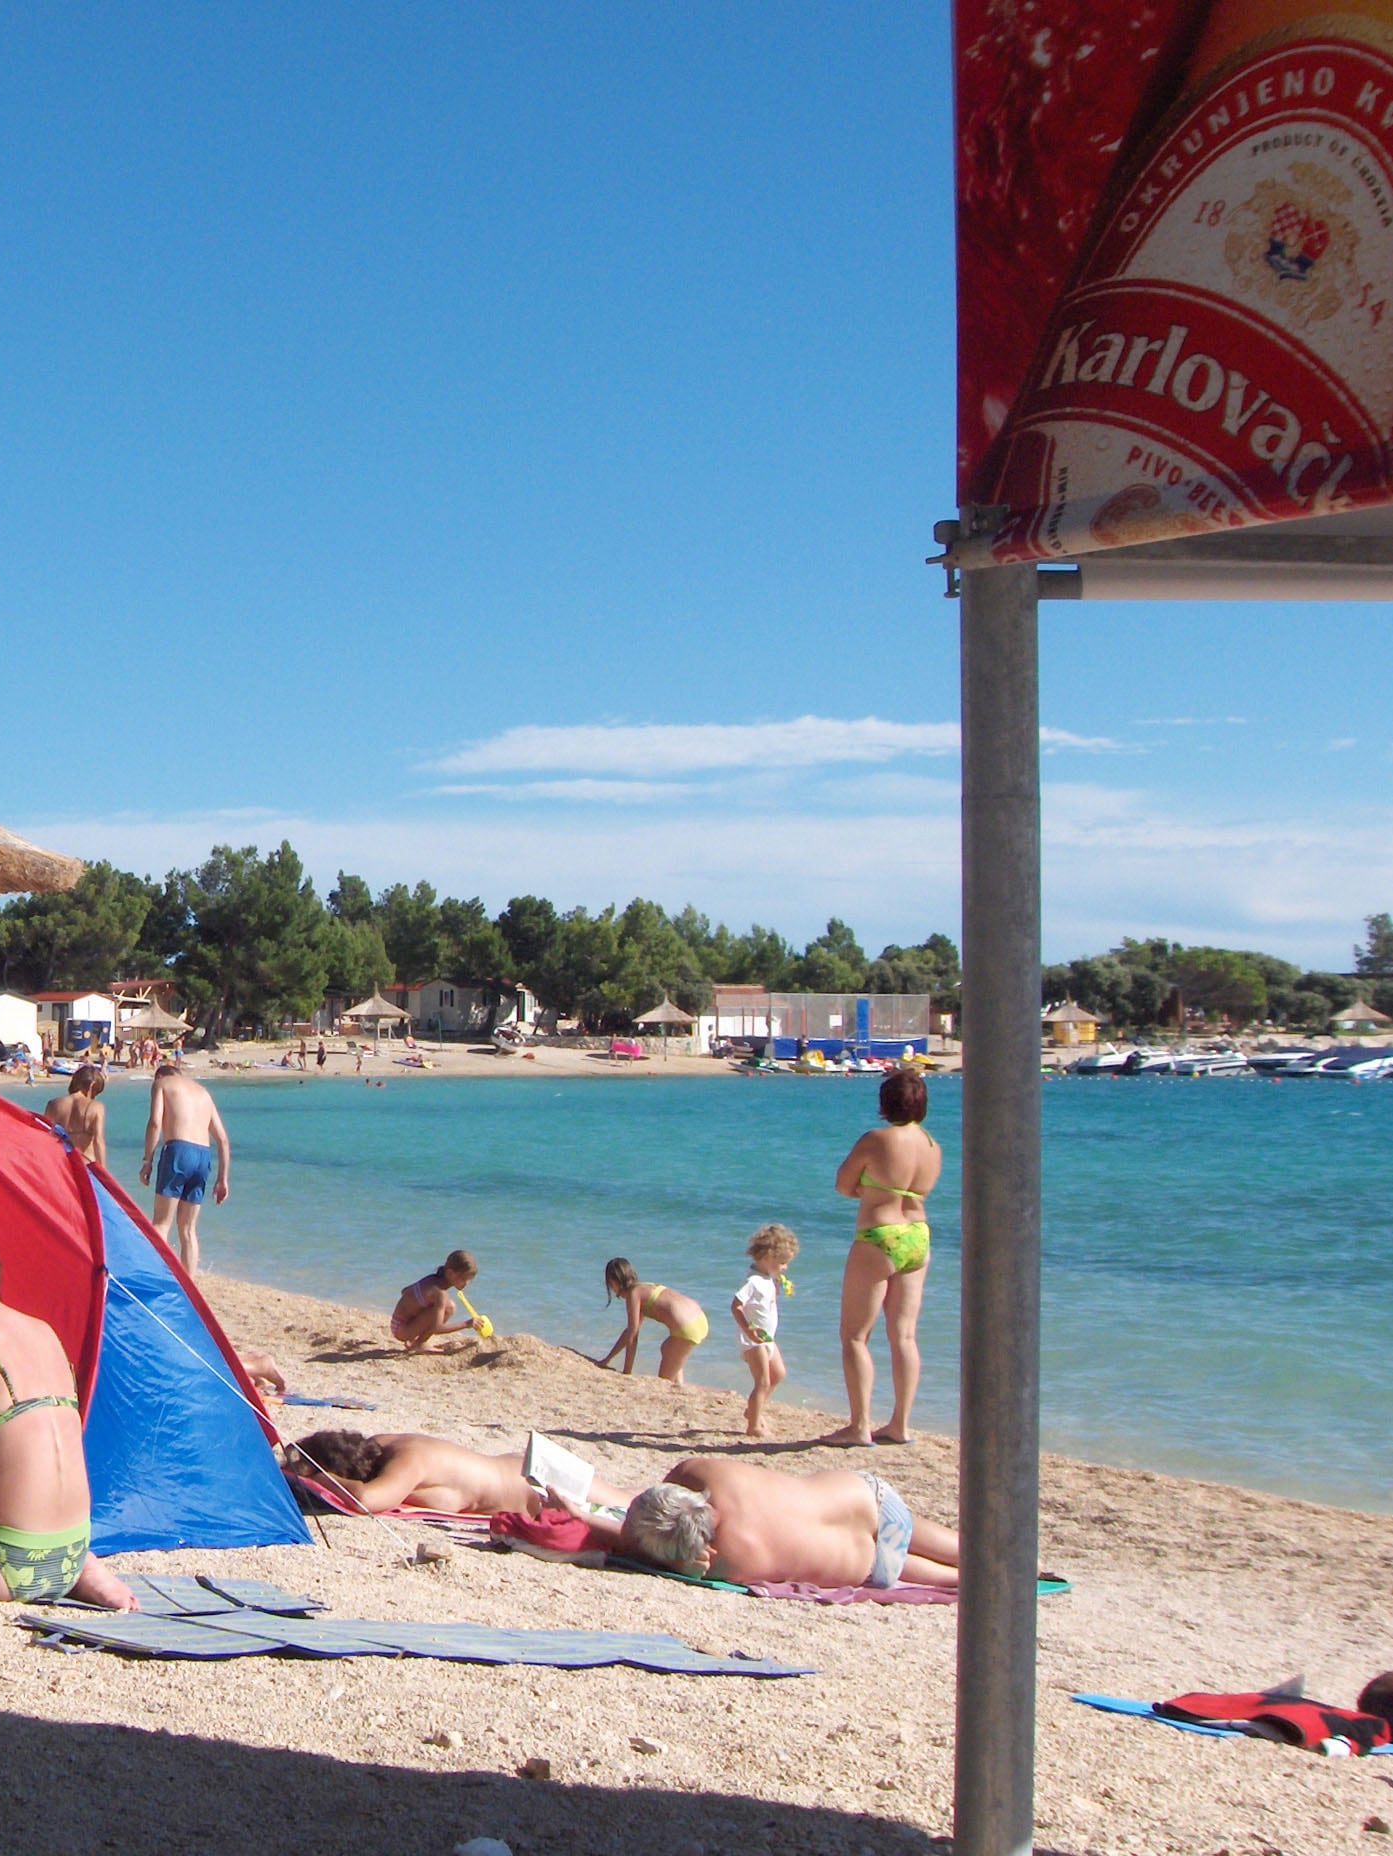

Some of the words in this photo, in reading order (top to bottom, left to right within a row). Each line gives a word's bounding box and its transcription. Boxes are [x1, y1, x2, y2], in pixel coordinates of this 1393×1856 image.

[1119, 66, 1336, 233] OKRUNJENO
[1252, 133, 1325, 157] PRODUCT
[1329, 139, 1349, 156] OF
[1191, 200, 1227, 227] 18
